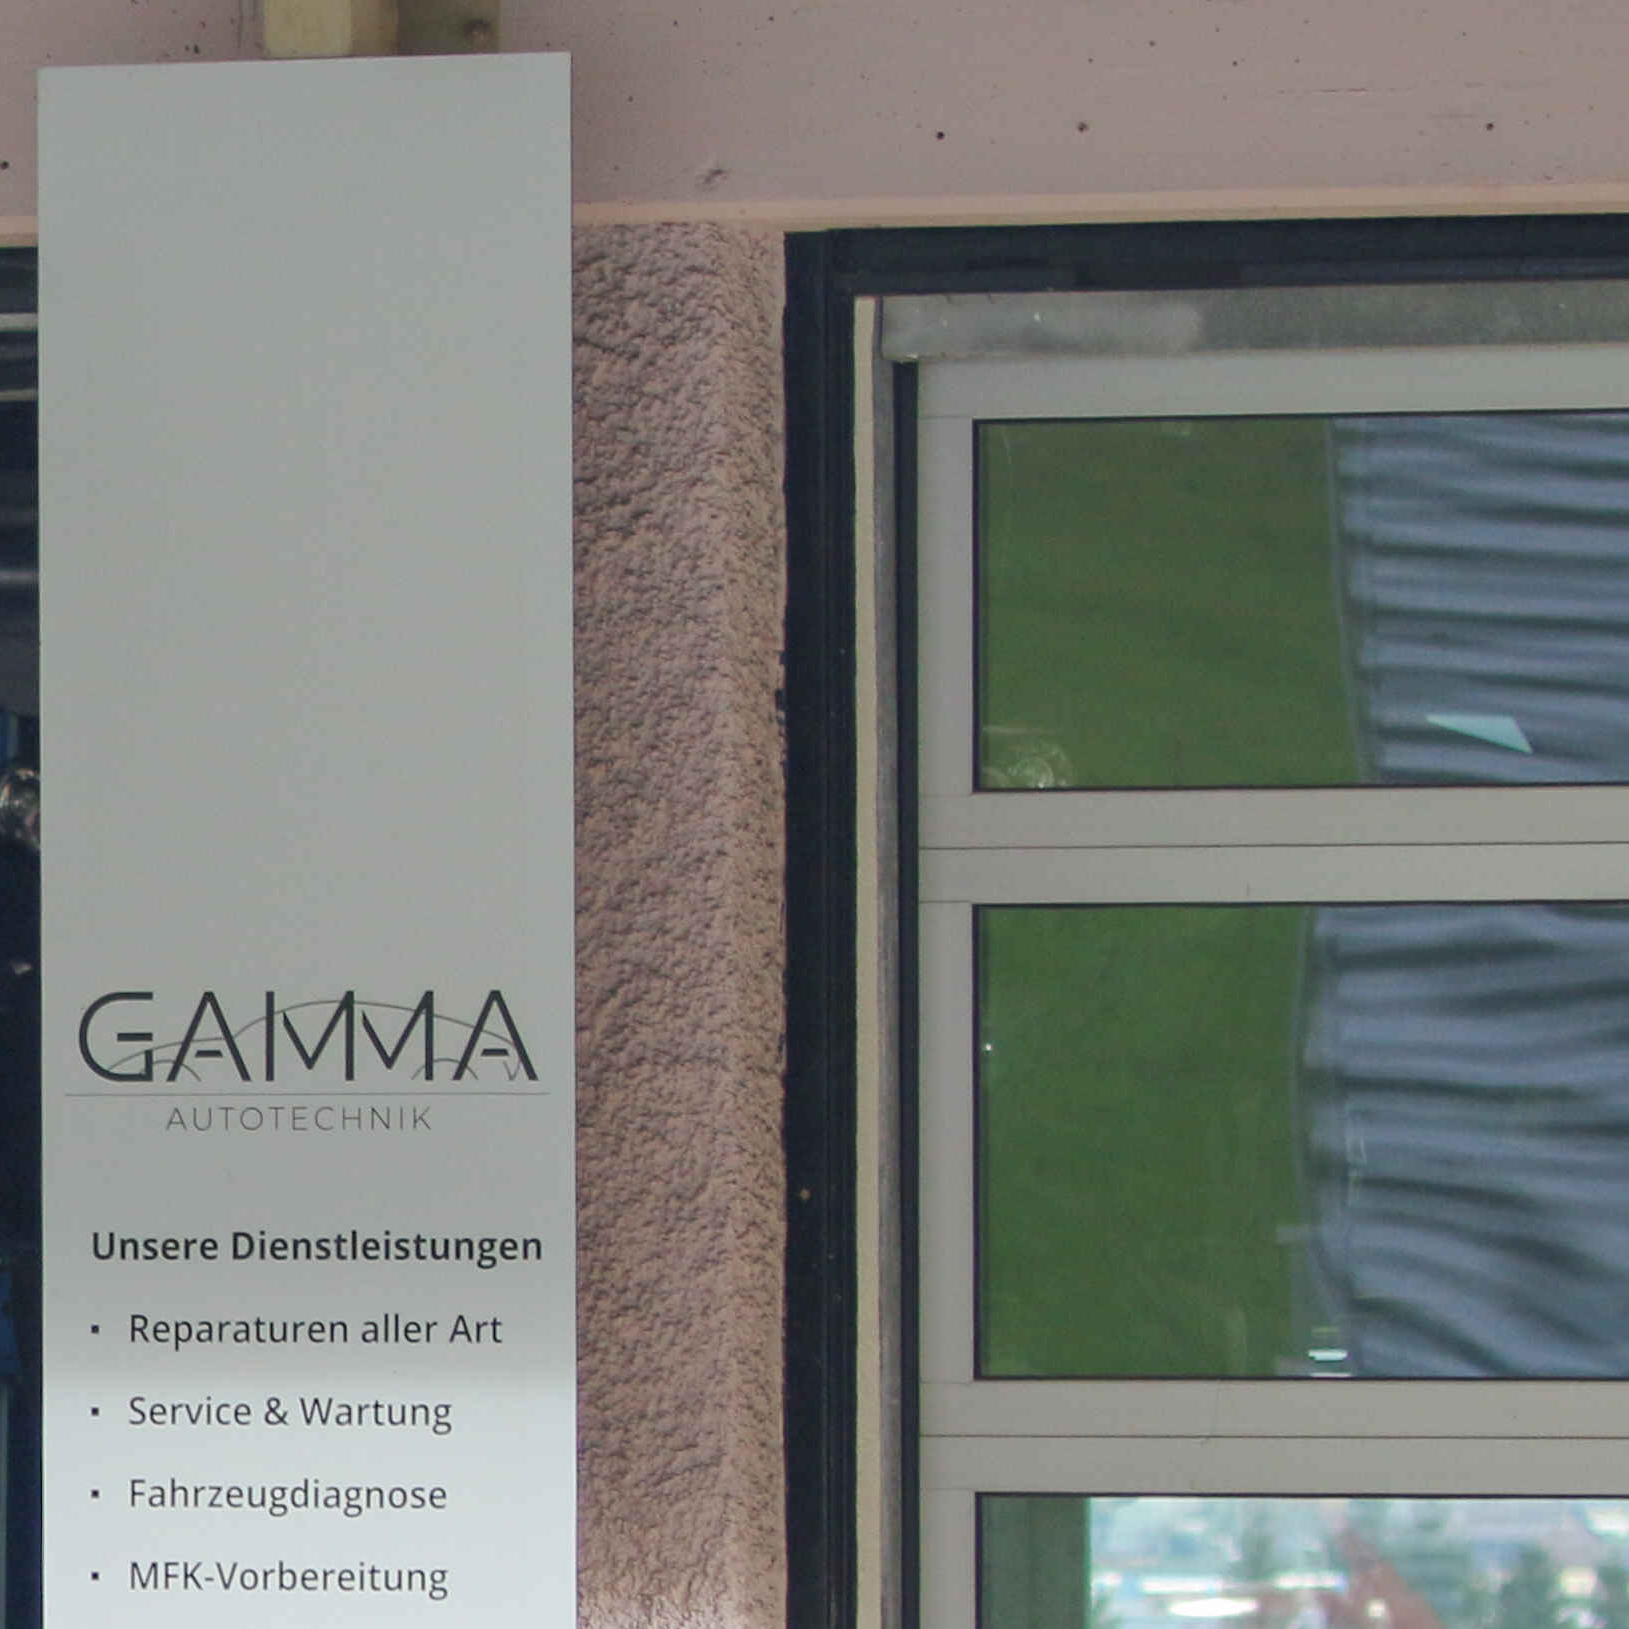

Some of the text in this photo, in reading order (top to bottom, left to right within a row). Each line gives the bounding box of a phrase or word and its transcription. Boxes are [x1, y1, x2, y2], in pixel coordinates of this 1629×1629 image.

[78, 989, 539, 1083] GAMMA
[165, 1105, 432, 1132] AUTOTECHNIK
[92, 1229, 542, 1270] Unsere Dienstleistungen
[130, 1313, 503, 1352] Reparaturen aller Art
[129, 1395, 452, 1436] Service & Wartung
[130, 1477, 447, 1518] Fahrzeugdiagnose
[130, 1560, 448, 1601] MFK-Vorbereitung
